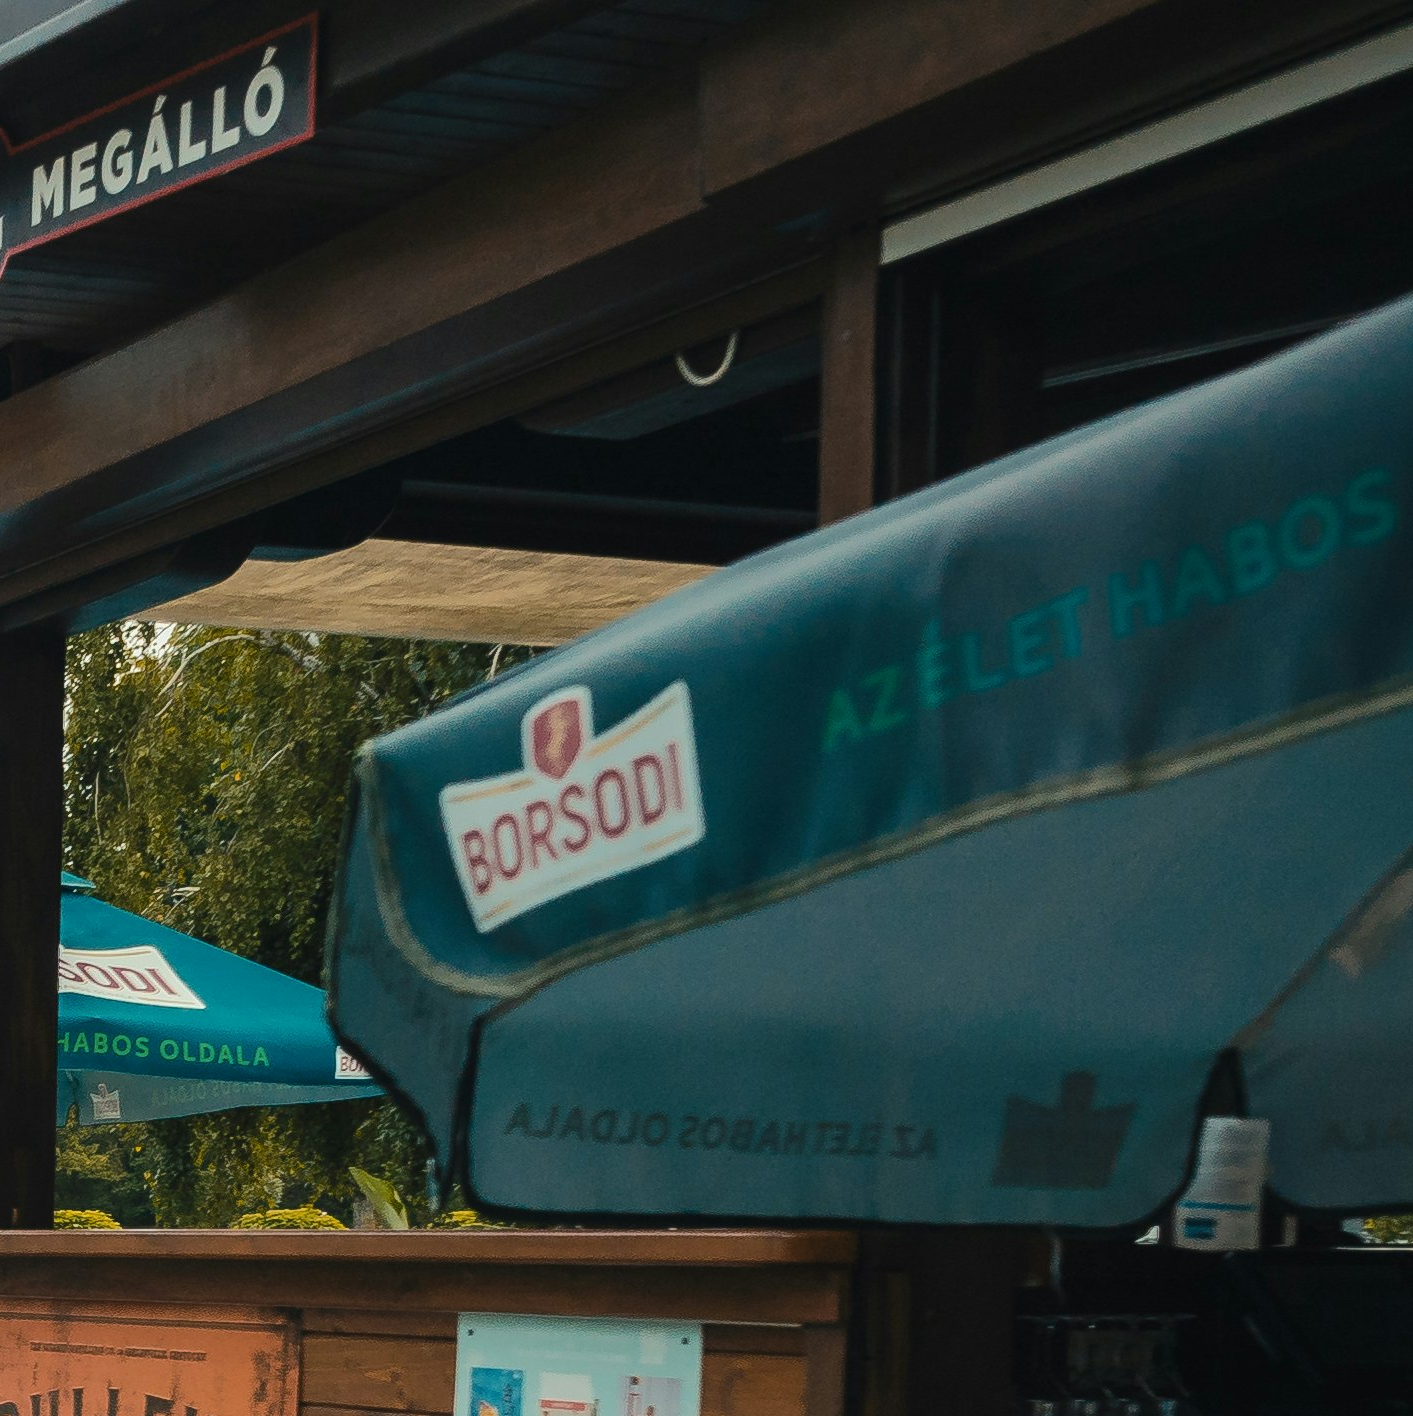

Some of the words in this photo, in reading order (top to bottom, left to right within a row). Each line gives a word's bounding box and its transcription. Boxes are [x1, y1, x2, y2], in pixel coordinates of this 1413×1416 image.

[31, 46, 285, 227] MEGÁLLÓ
[821, 665, 909, 755] AZ
[916, 615, 1089, 710] ÉLET
[1107, 468, 1399, 641] HABOS
[462, 741, 684, 896] BORSODI
[160, 1039, 270, 1067] OLDALA
